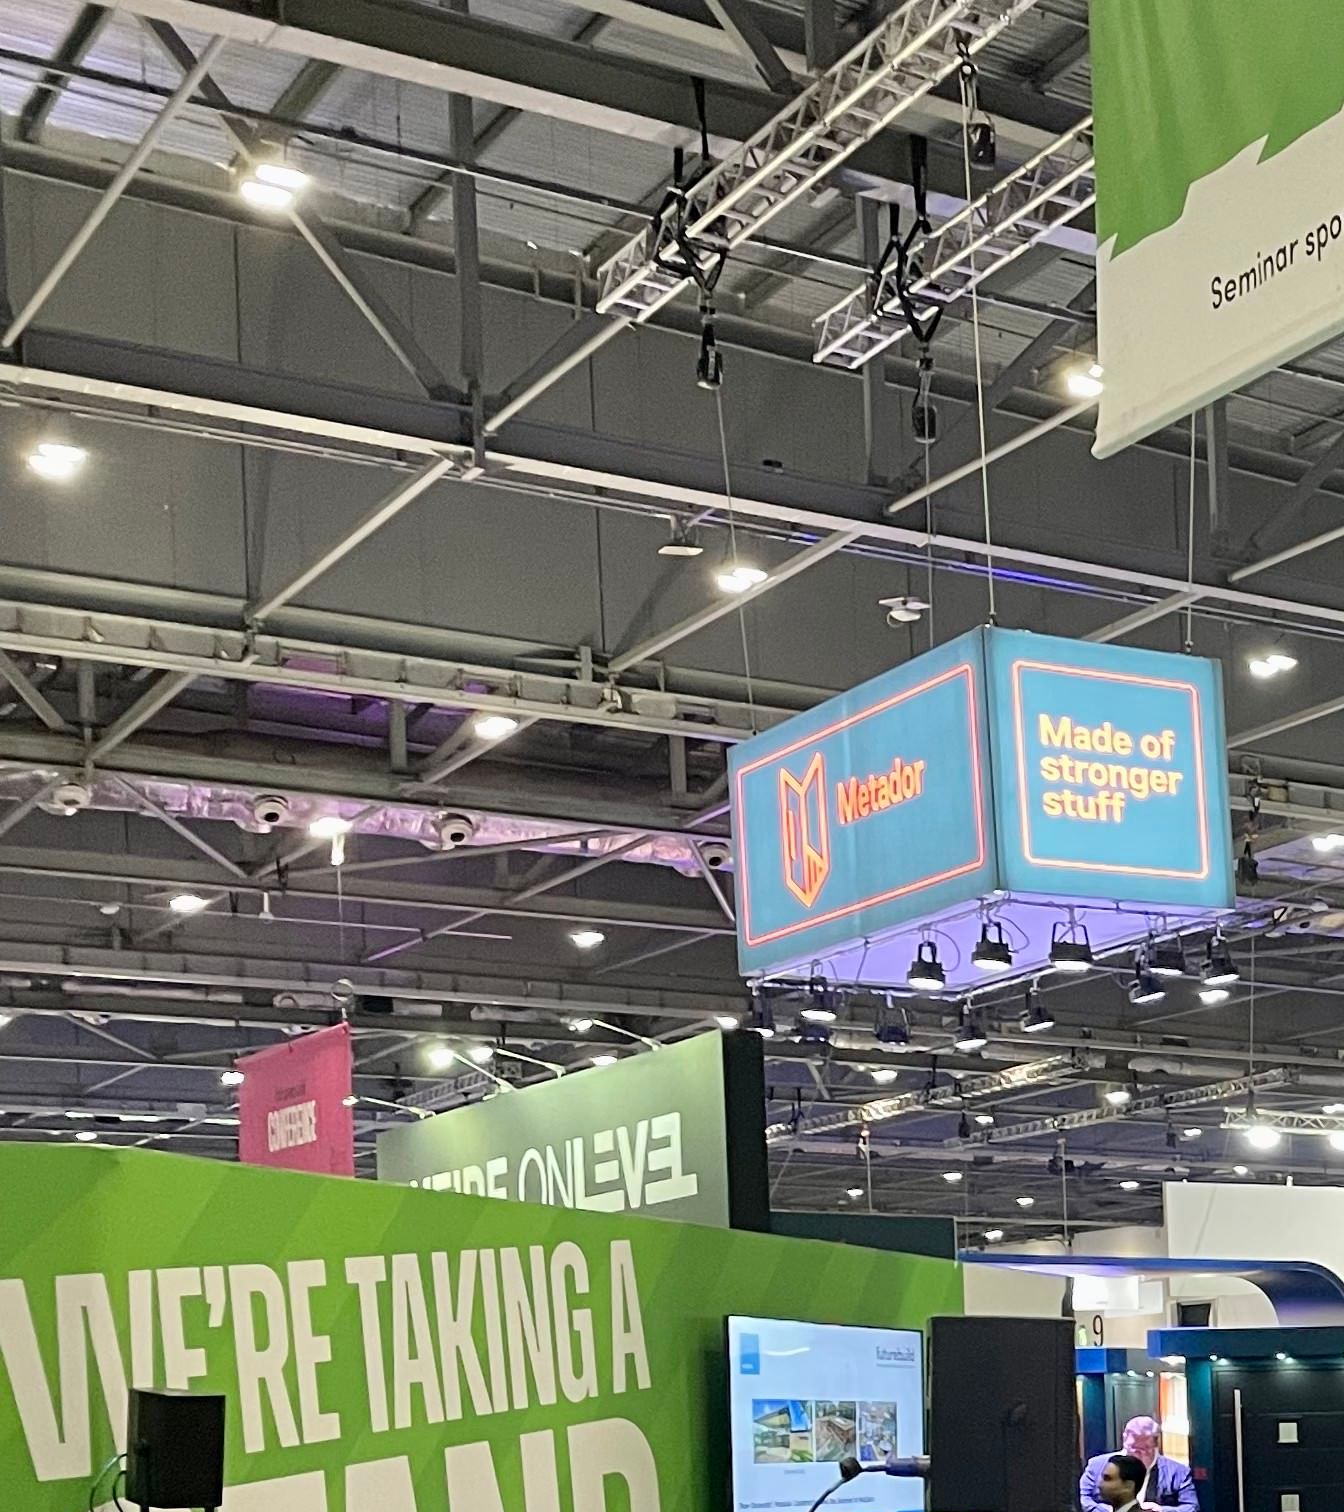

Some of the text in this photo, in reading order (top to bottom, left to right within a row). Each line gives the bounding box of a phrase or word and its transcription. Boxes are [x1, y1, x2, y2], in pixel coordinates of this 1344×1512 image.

[1210, 241, 1300, 311] Seminar
[1038, 713, 1176, 762] Made of
[836, 757, 926, 825] Metador
[1040, 754, 1184, 800] stronger
[1043, 789, 1126, 823] stuff
[0, 1239, 653, 1481] WE'RE TAKING A
